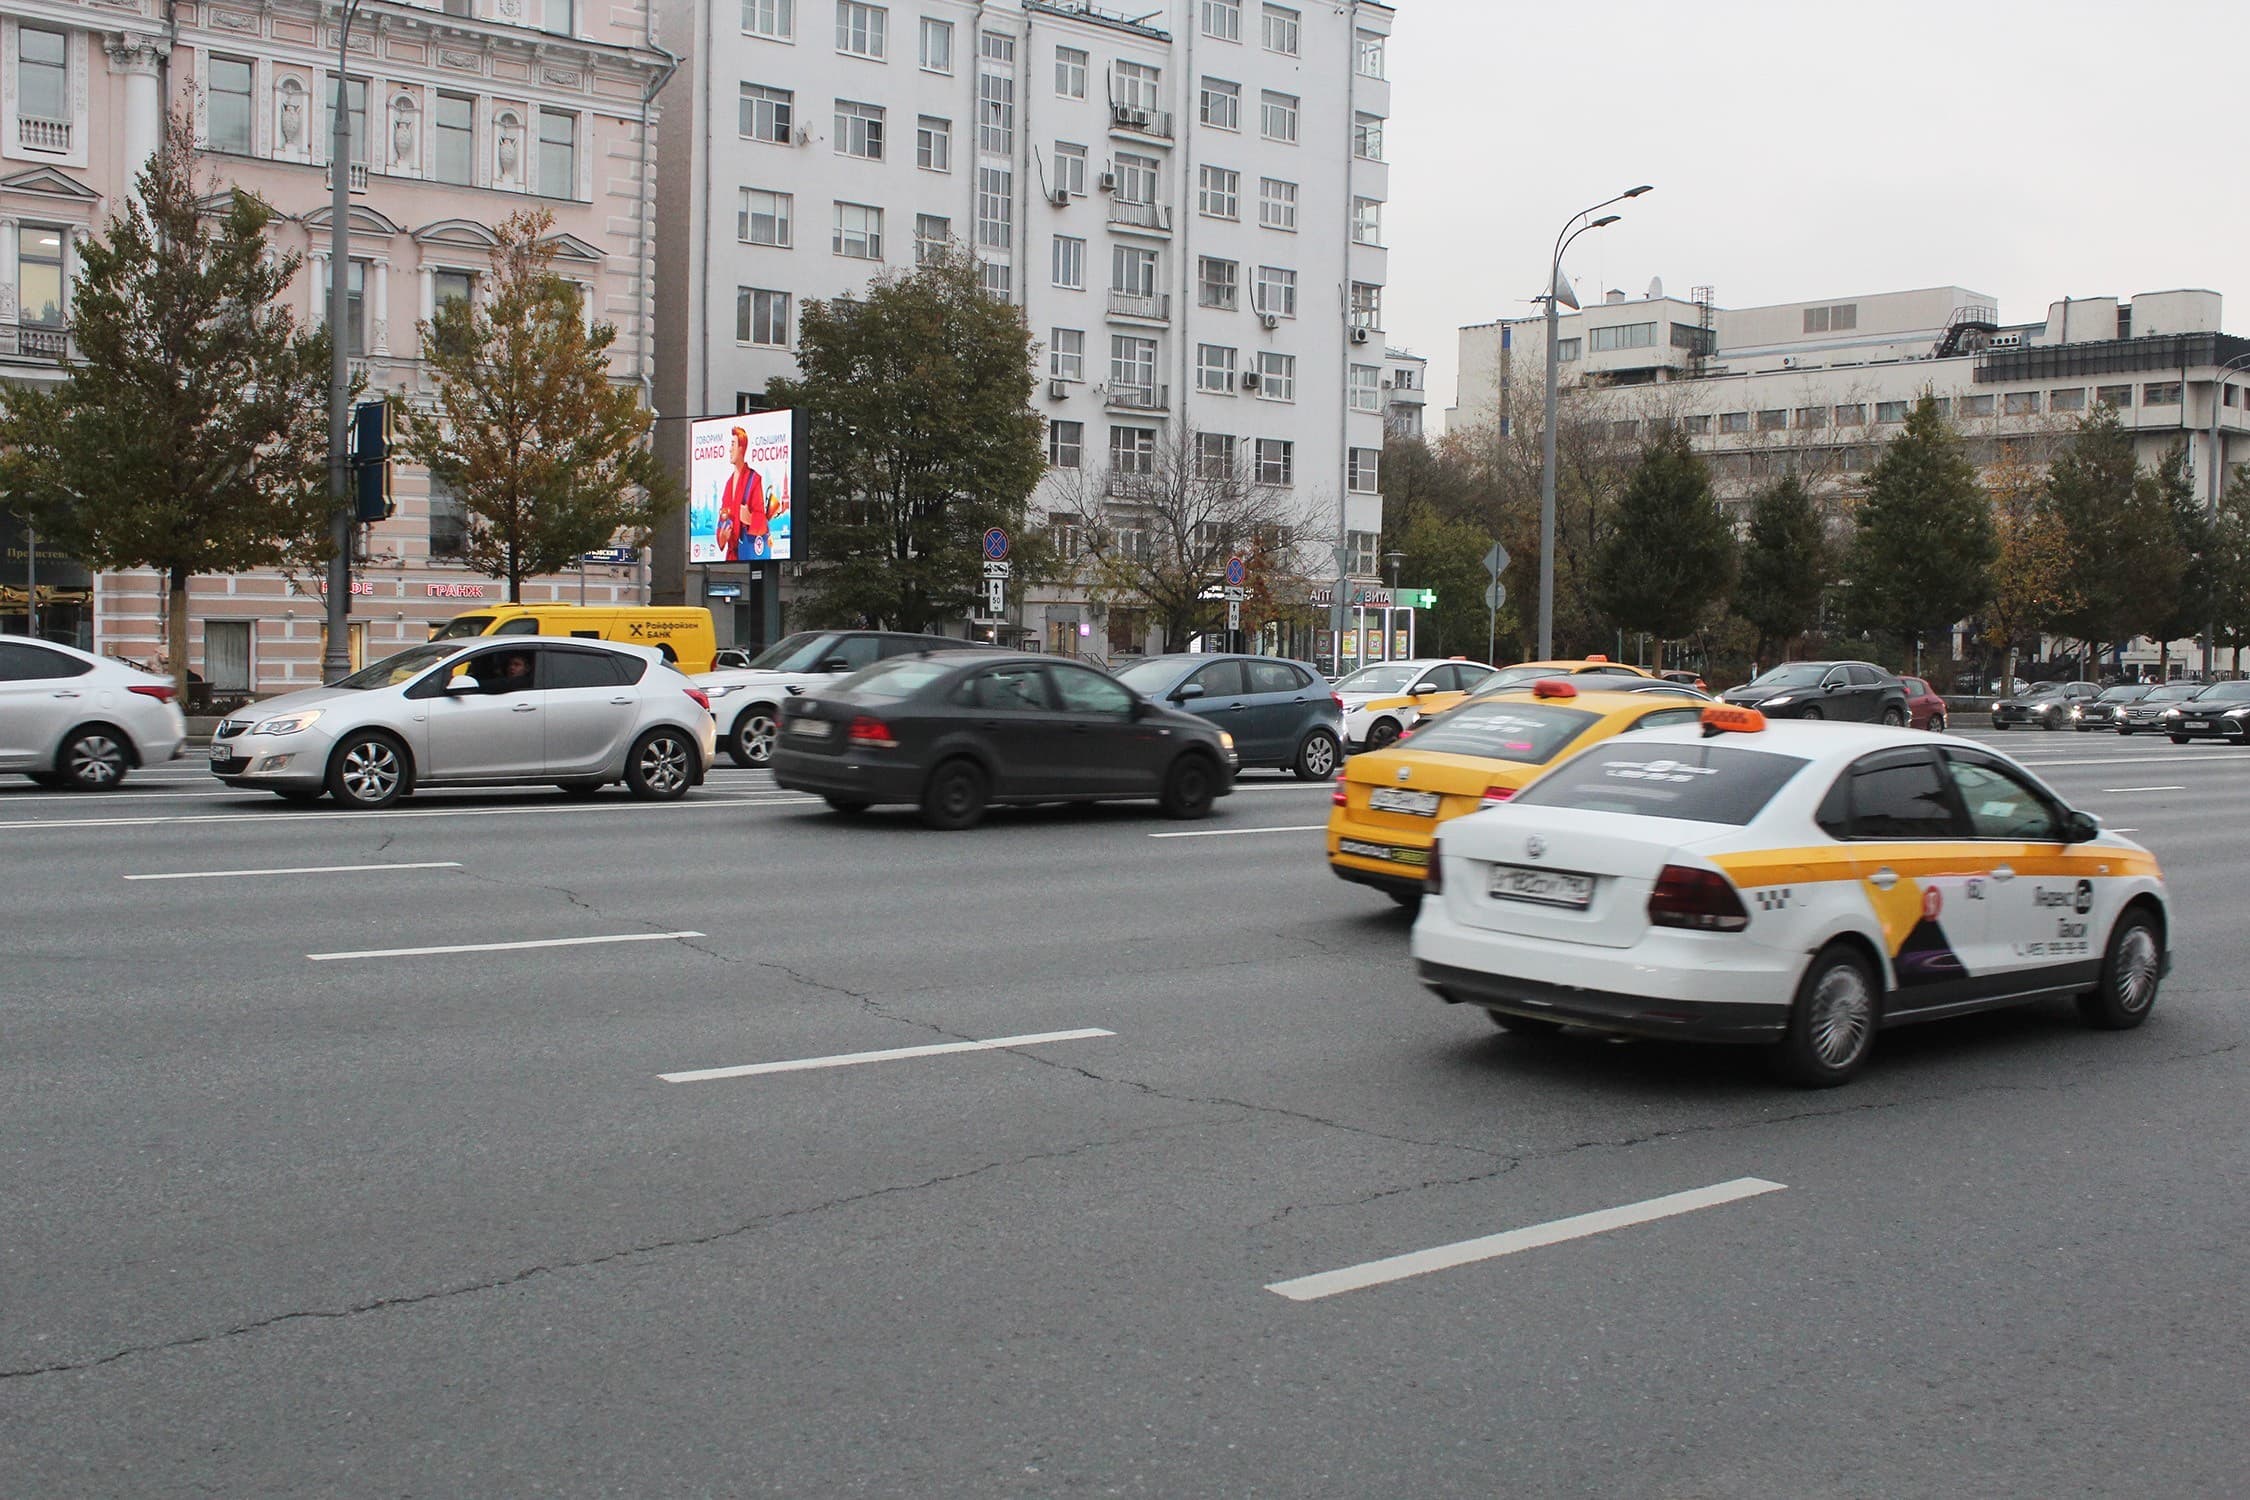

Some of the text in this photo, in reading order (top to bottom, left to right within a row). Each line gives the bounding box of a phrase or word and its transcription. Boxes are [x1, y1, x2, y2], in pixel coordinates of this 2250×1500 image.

[695, 433, 724, 445] ГОВОРИМ
[755, 433, 786, 446] СЛЫШИМ
[694, 445, 725, 461] САМБО
[751, 445, 789, 462] РОССИЯ
[426, 583, 484, 598] ГРАНЖ
[1364, 591, 1391, 603] ВИТА
